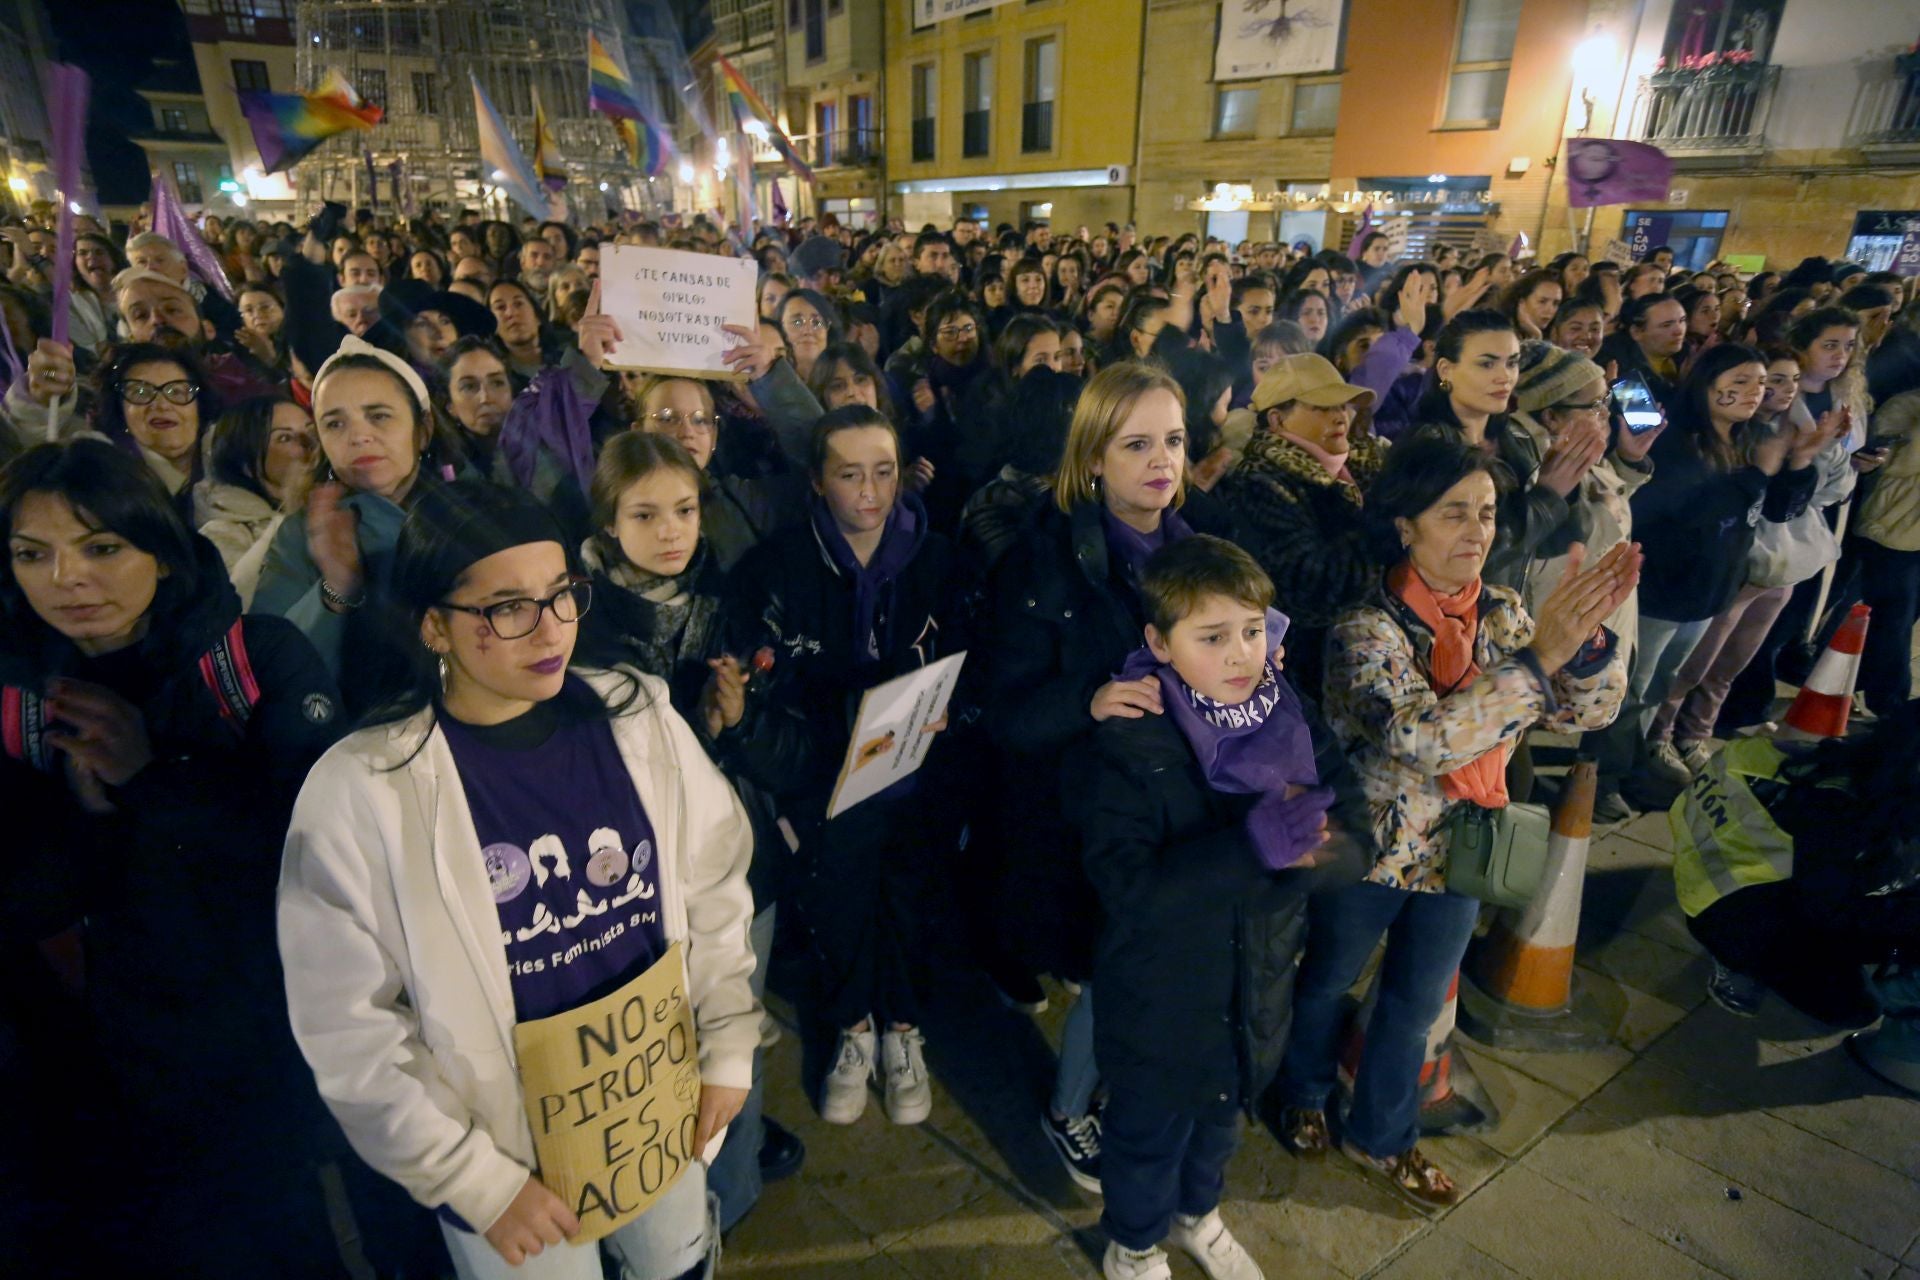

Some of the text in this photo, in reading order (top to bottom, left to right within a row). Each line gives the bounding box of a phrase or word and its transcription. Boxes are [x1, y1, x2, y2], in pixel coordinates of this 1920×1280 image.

[1634, 235, 1649, 244] CA
[1638, 217, 1651, 226] SE
[661, 271, 713, 287] CANSAS
[716, 276, 731, 288] DE
[638, 309, 709, 326] NOSOTRAS
[657, 331, 710, 345] VIVIRLO
[551, 921, 625, 968] Feminista
[630, 911, 656, 928] 8M
[576, 985, 681, 1068] NO es
[540, 1022, 687, 1135] PIROPO
[604, 1096, 660, 1167] ES
[575, 1113, 698, 1221] ACOSO
